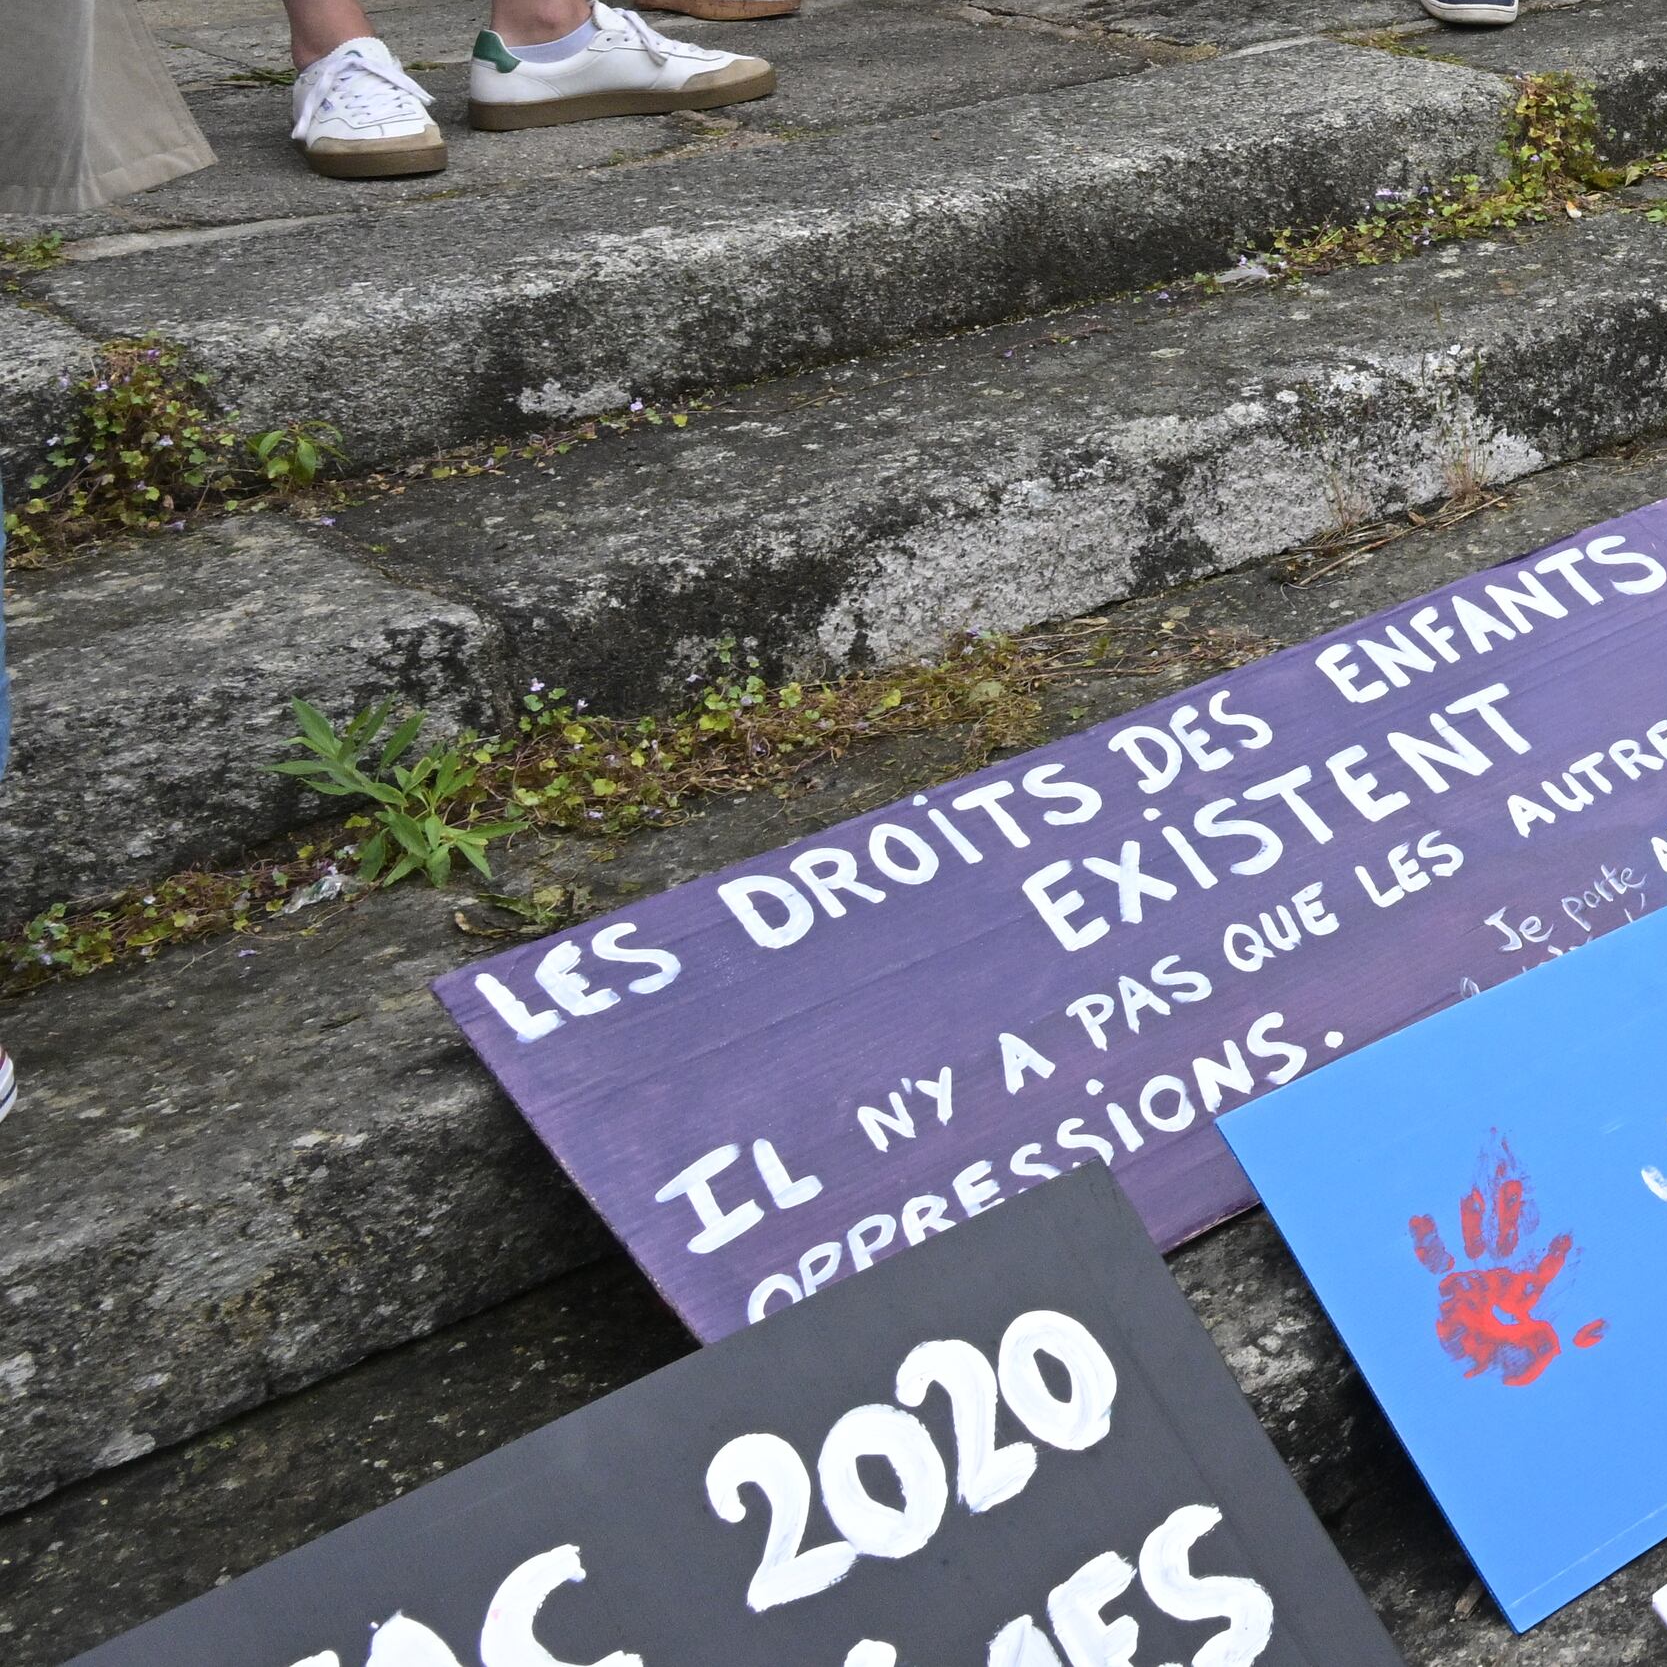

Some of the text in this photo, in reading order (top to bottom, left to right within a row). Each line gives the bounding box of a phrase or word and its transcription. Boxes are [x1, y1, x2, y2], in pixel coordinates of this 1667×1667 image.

[472, 919, 682, 1044] LES
[1105, 689, 1274, 796] DES
[1483, 906, 1555, 954] Je
[1560, 864, 1649, 933] porte
[652, 1134, 826, 1258] IL
[857, 1066, 952, 1153] N'Y
[999, 1032, 1055, 1095] A
[1064, 950, 1216, 1054] PAS
[1220, 879, 1342, 979] QUE
[1354, 829, 1465, 908] LES
[703, 1307, 1120, 1614] 2020
